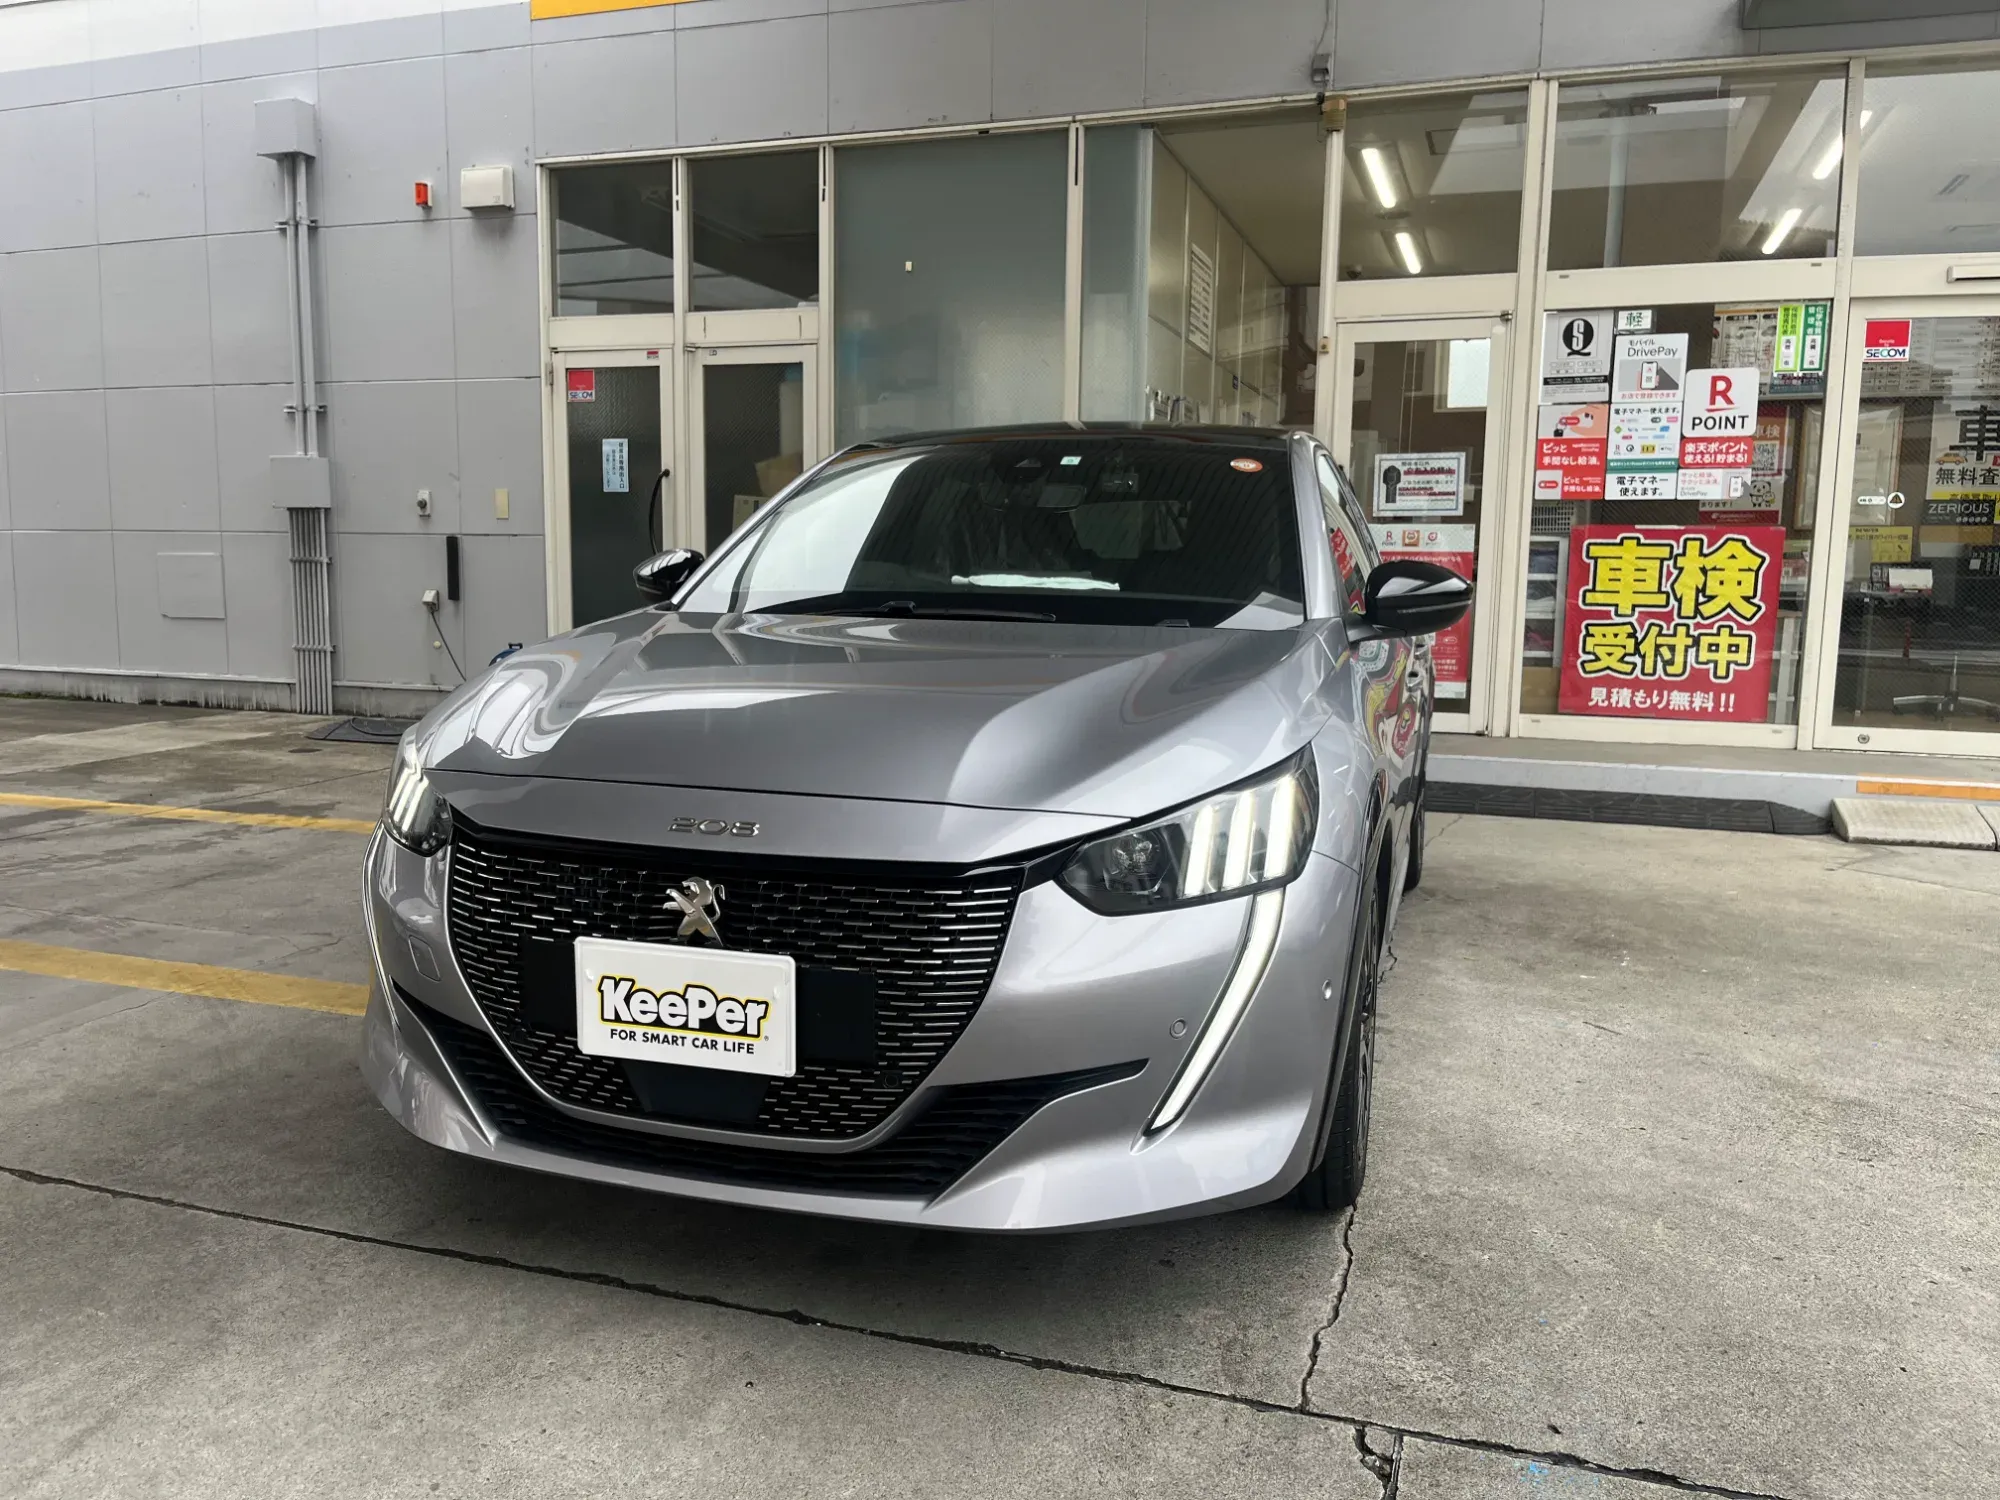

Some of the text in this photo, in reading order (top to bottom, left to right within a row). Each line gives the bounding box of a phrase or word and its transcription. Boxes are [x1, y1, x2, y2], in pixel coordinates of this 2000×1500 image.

[1625, 311, 1644, 327] 軽
[1629, 338, 1655, 346] モバイル
[1627, 346, 1677, 358] DrivePay
[1866, 348, 1906, 358] SECOM
[570, 391, 593, 399] SECOM
[1709, 375, 1735, 406] R
[1614, 407, 1680, 415] 電子マネー使えます。
[1692, 416, 1749, 431] POINT
[1543, 442, 1567, 453] ピッと
[1684, 442, 1749, 454] 楽天ポイント
[1542, 456, 1600, 466] 手間なし給油。
[1616, 475, 1669, 486] 電子マネー
[1935, 466, 2000, 486] 無料査
[1619, 487, 1663, 497] 使えます。
[1928, 503, 1990, 514] ZERIOUS
[1585, 536, 1767, 622] 車検
[1581, 621, 1752, 680] 受付中
[667, 817, 760, 838] 208
[599, 975, 770, 1039] KeePer
[610, 1028, 755, 1055] FOR SMART CAR LIFE
